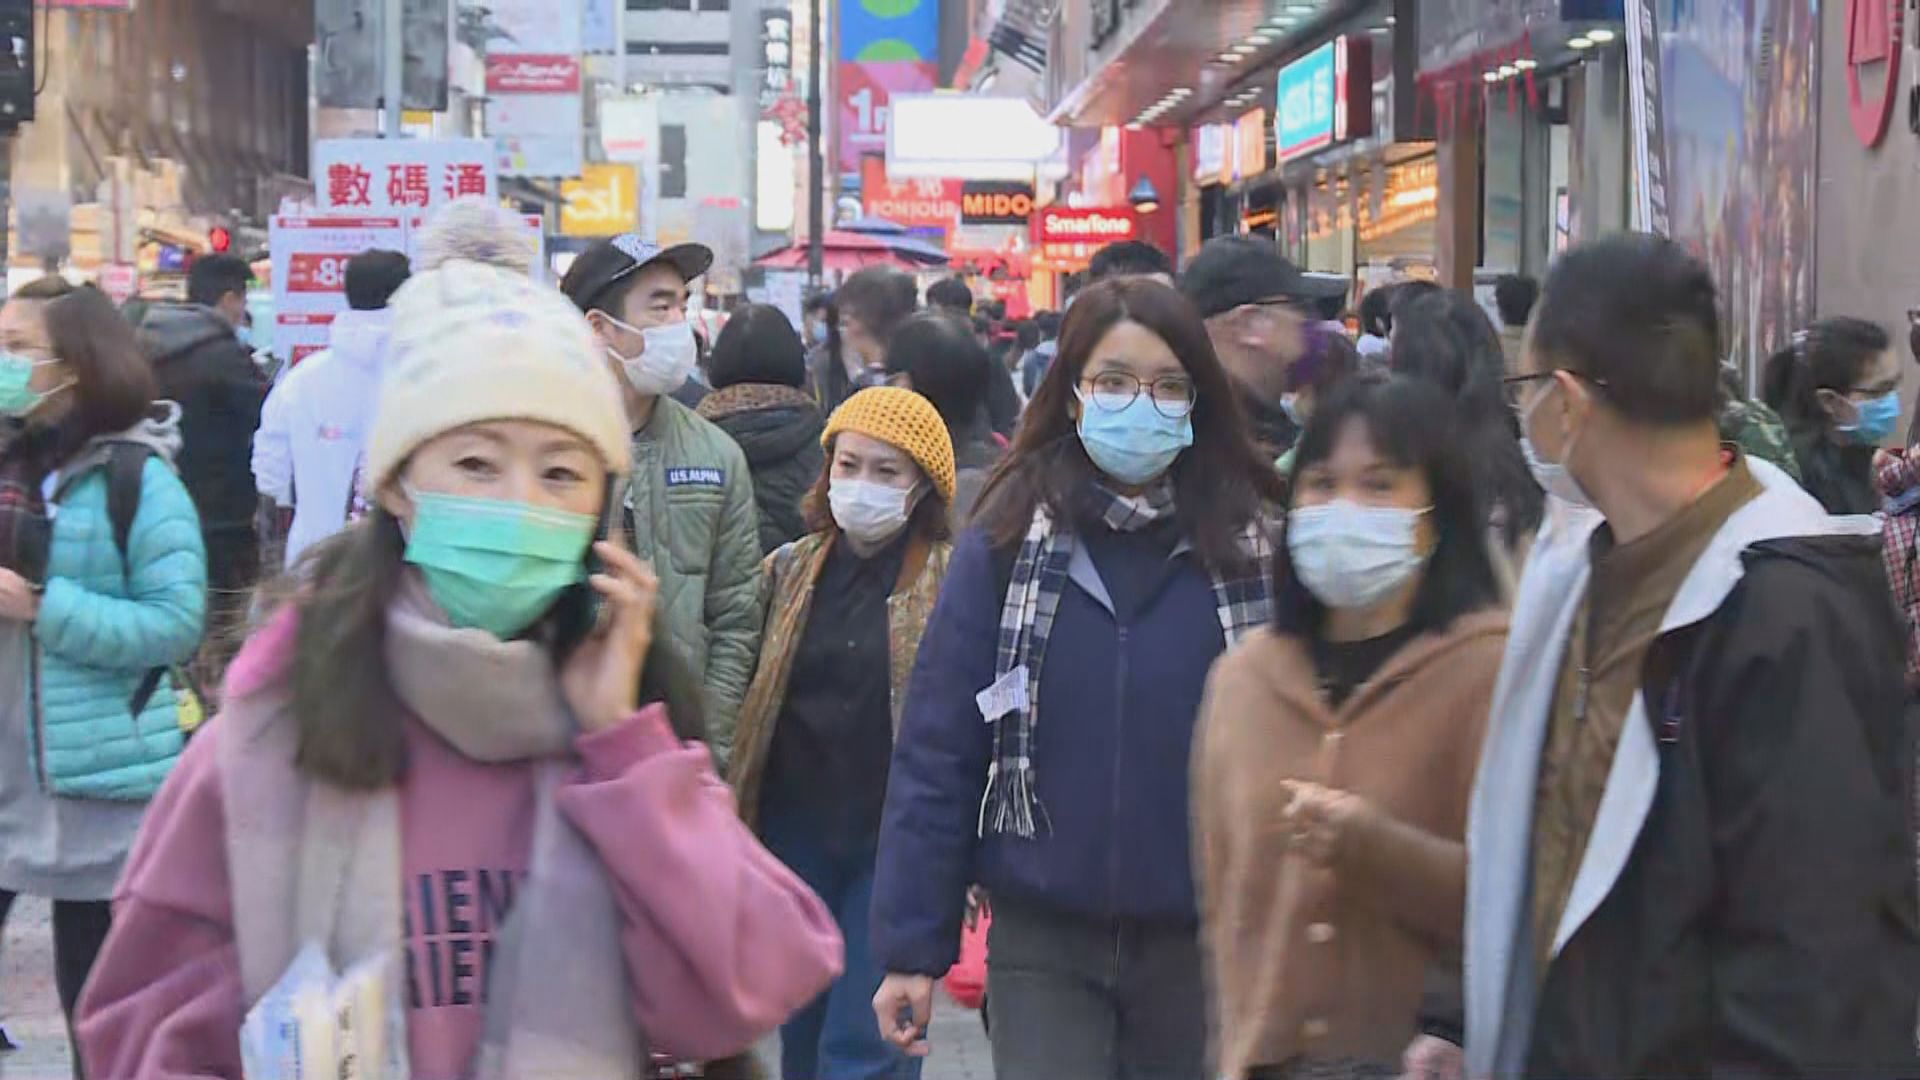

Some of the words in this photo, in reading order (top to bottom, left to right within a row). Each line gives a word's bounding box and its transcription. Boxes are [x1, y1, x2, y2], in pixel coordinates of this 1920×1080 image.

[327, 163, 486, 207] 數碼通
[963, 193, 1032, 216] MIDO
